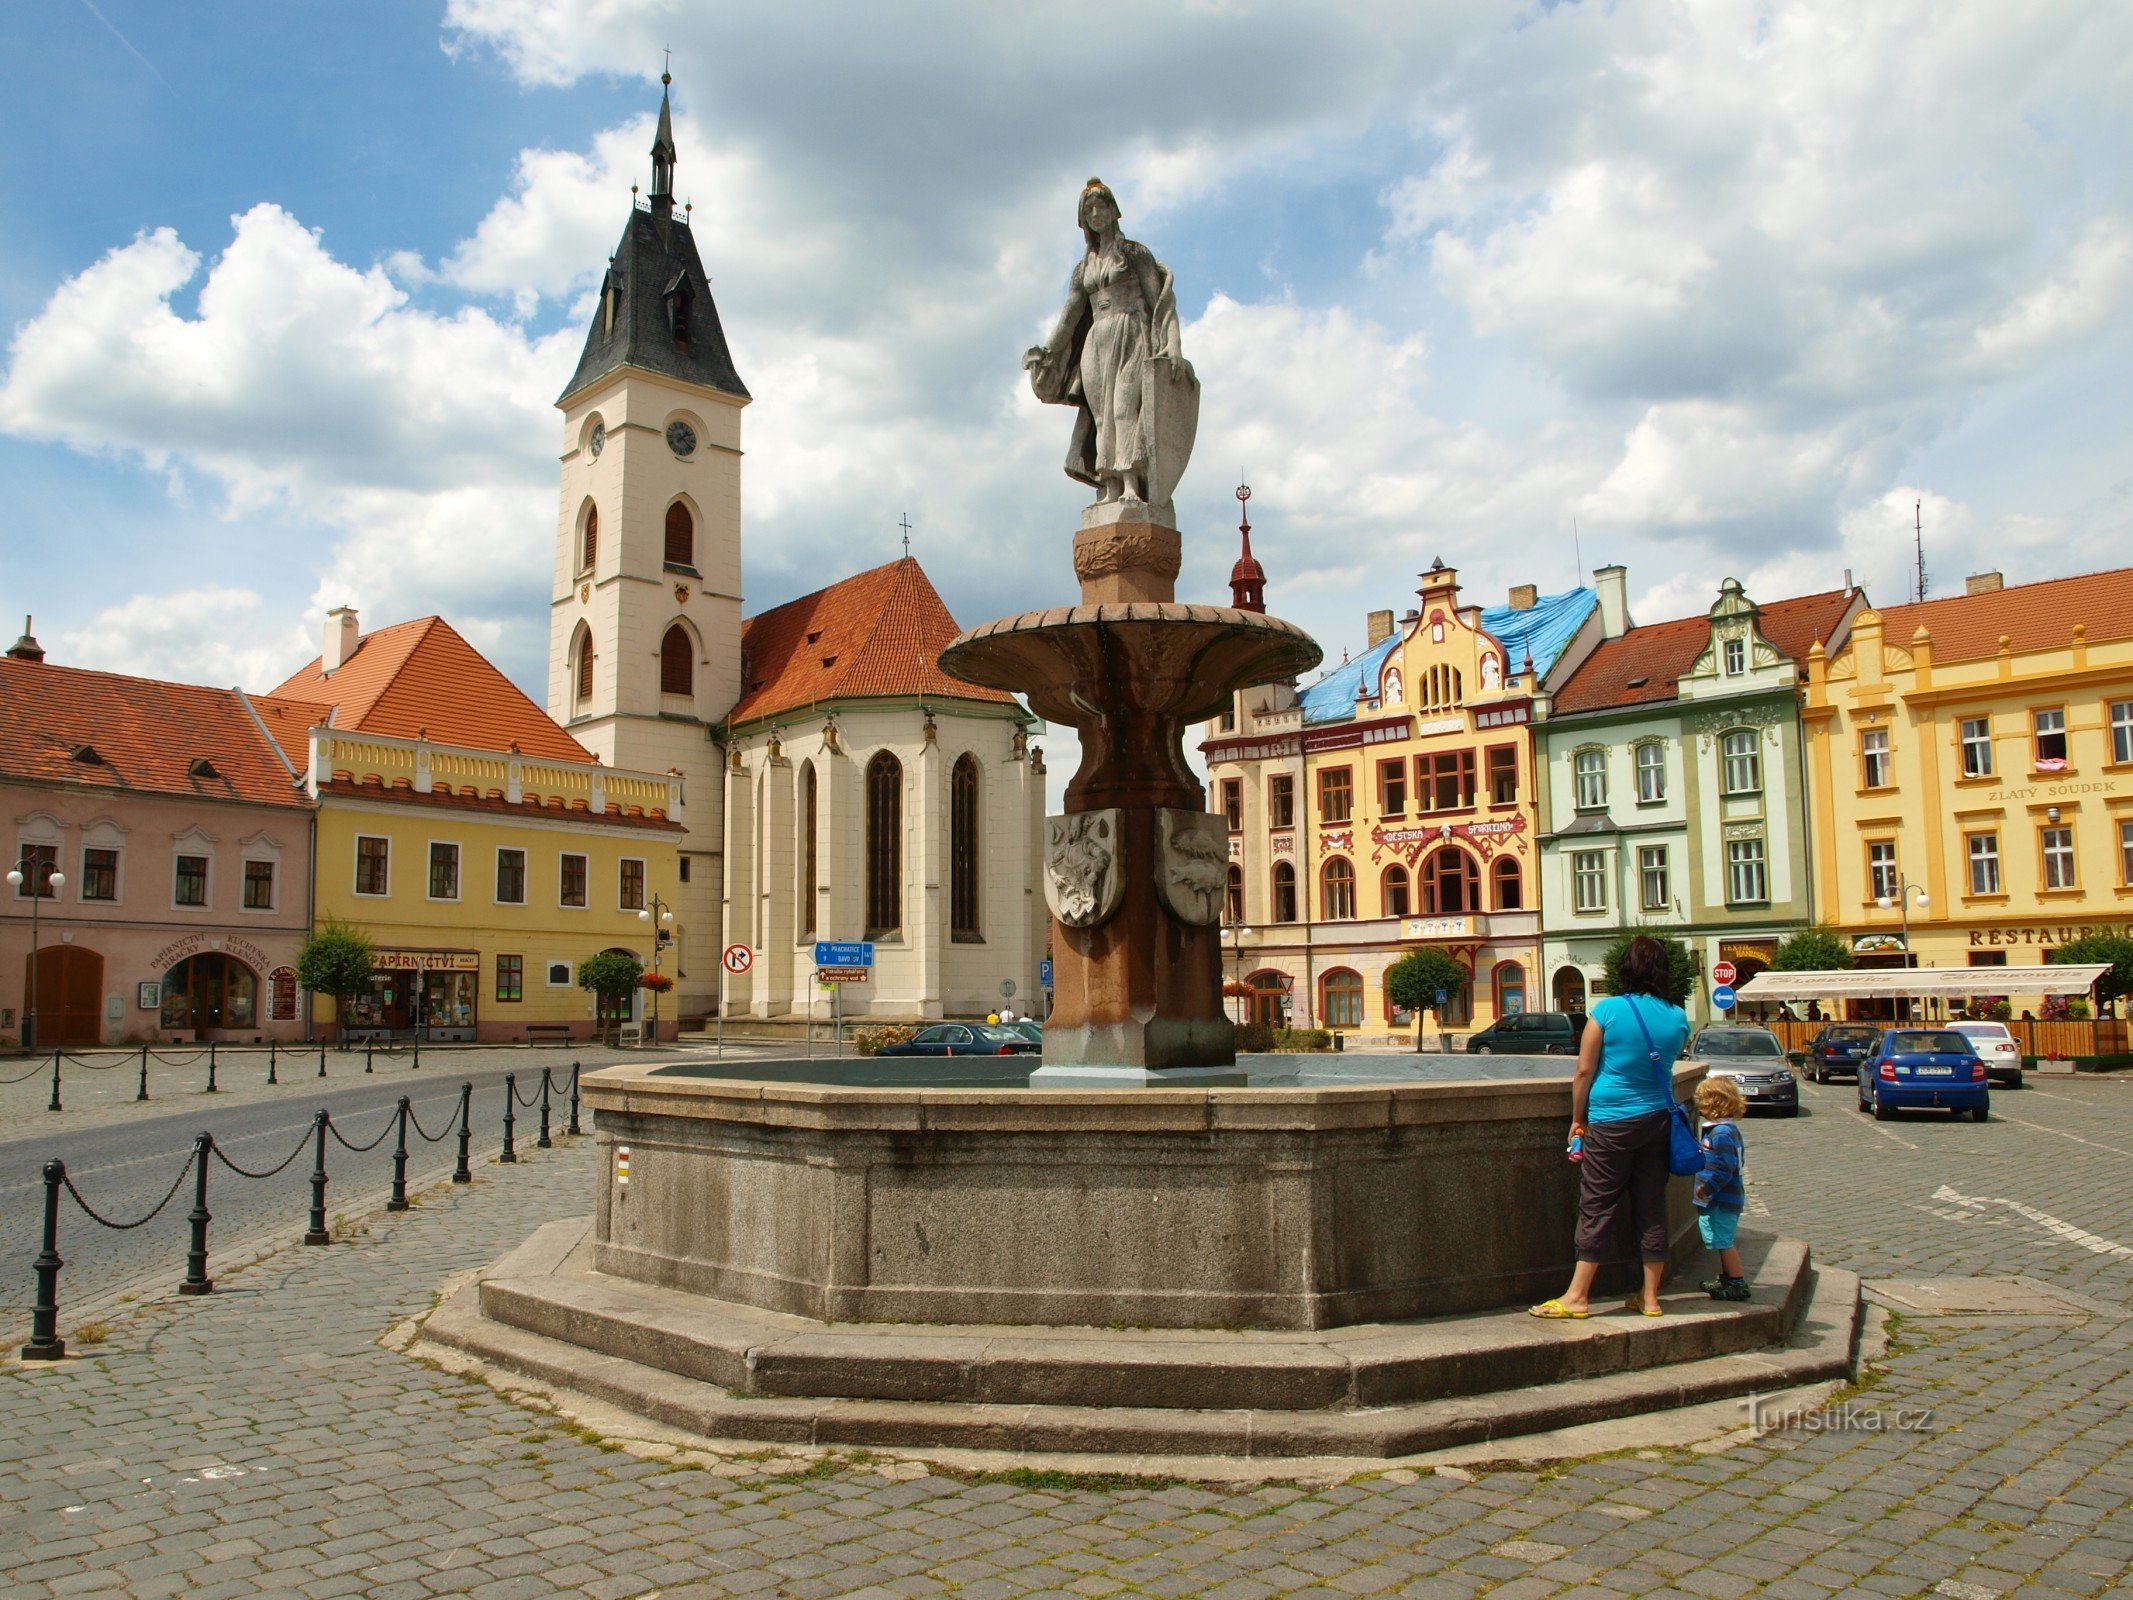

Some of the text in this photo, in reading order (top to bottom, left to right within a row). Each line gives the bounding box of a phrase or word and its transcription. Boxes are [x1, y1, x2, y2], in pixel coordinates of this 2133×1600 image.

[1989, 782, 2116, 801] ZLATÝ SOUDEK
[225, 943, 265, 972] KLENOTY
[1041, 963, 1050, 978] P
[1714, 968, 1734, 978] STOP
